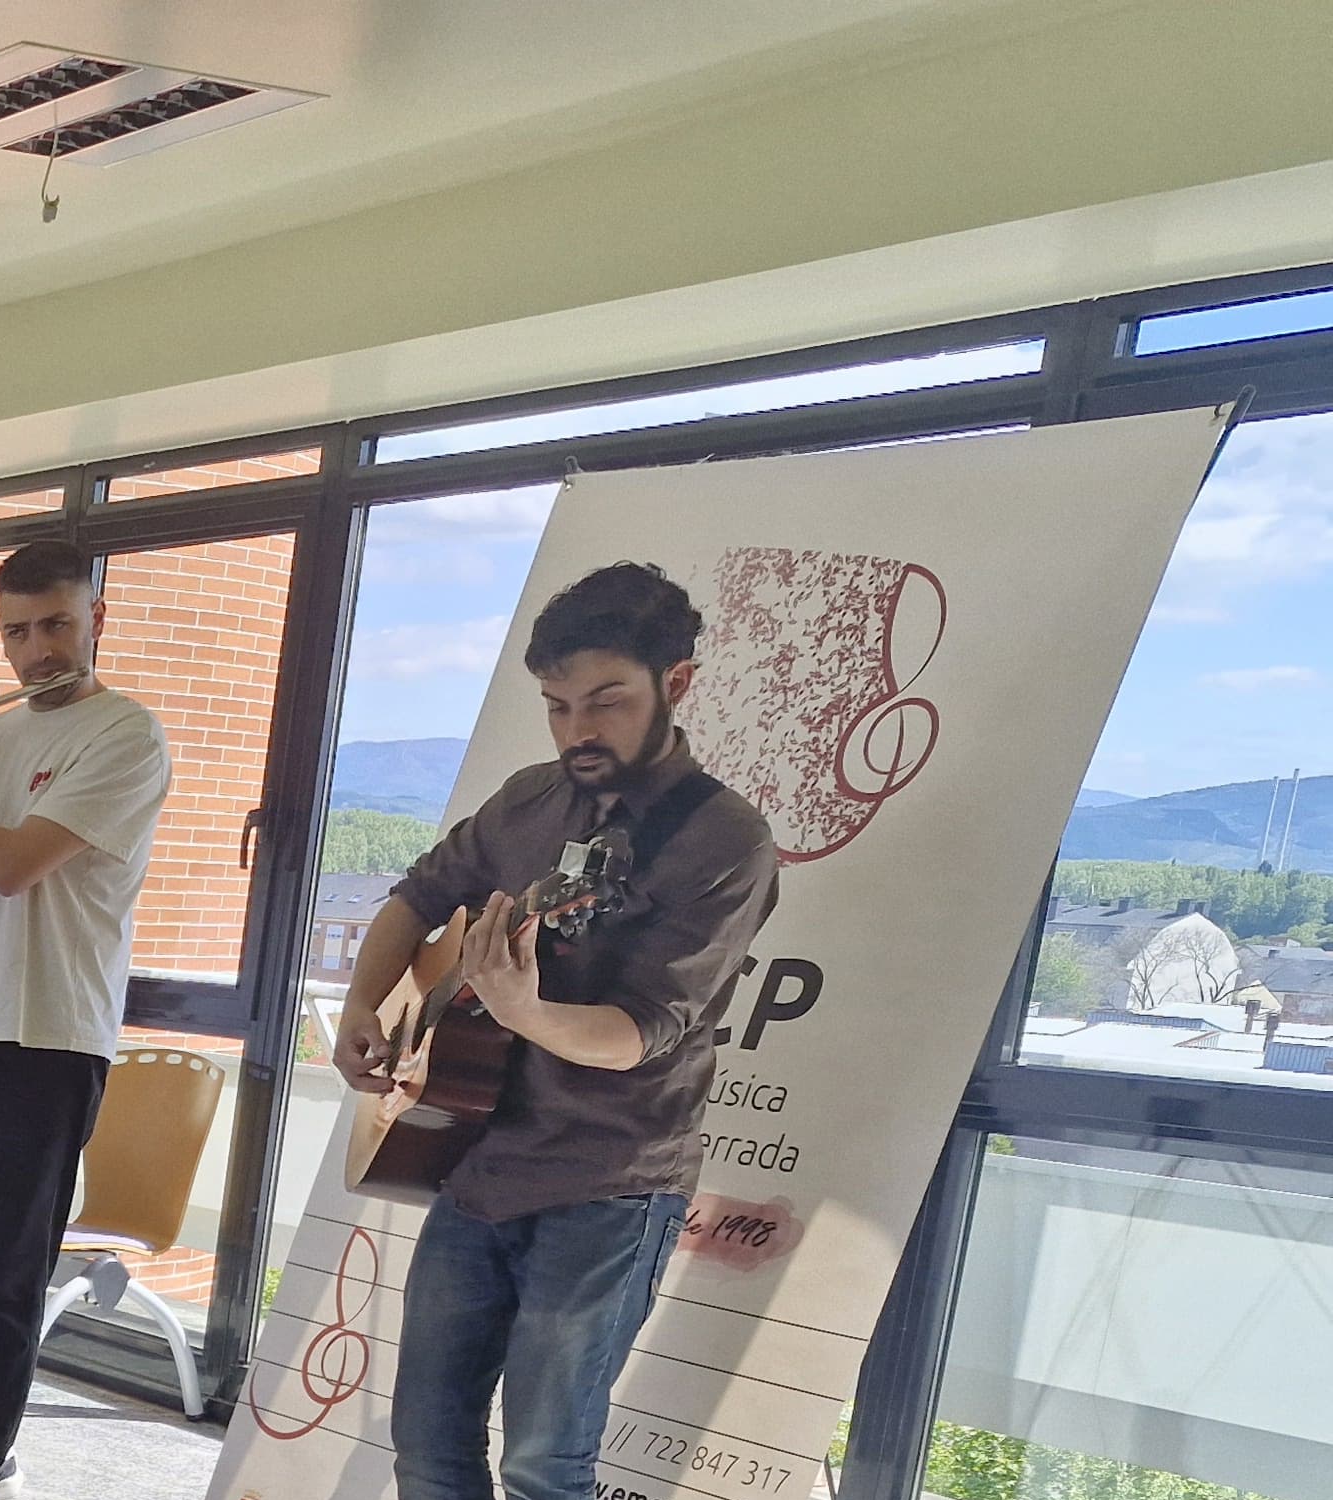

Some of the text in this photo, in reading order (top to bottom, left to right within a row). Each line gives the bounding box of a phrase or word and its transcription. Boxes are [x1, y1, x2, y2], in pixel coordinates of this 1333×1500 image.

[706, 1069, 788, 1113] úsica
[699, 1133, 800, 1173] errada
[711, 1215, 778, 1247] 1998
[644, 1432, 688, 1465] 722
[691, 1446, 740, 1478] 847
[741, 1460, 792, 1494] 317
